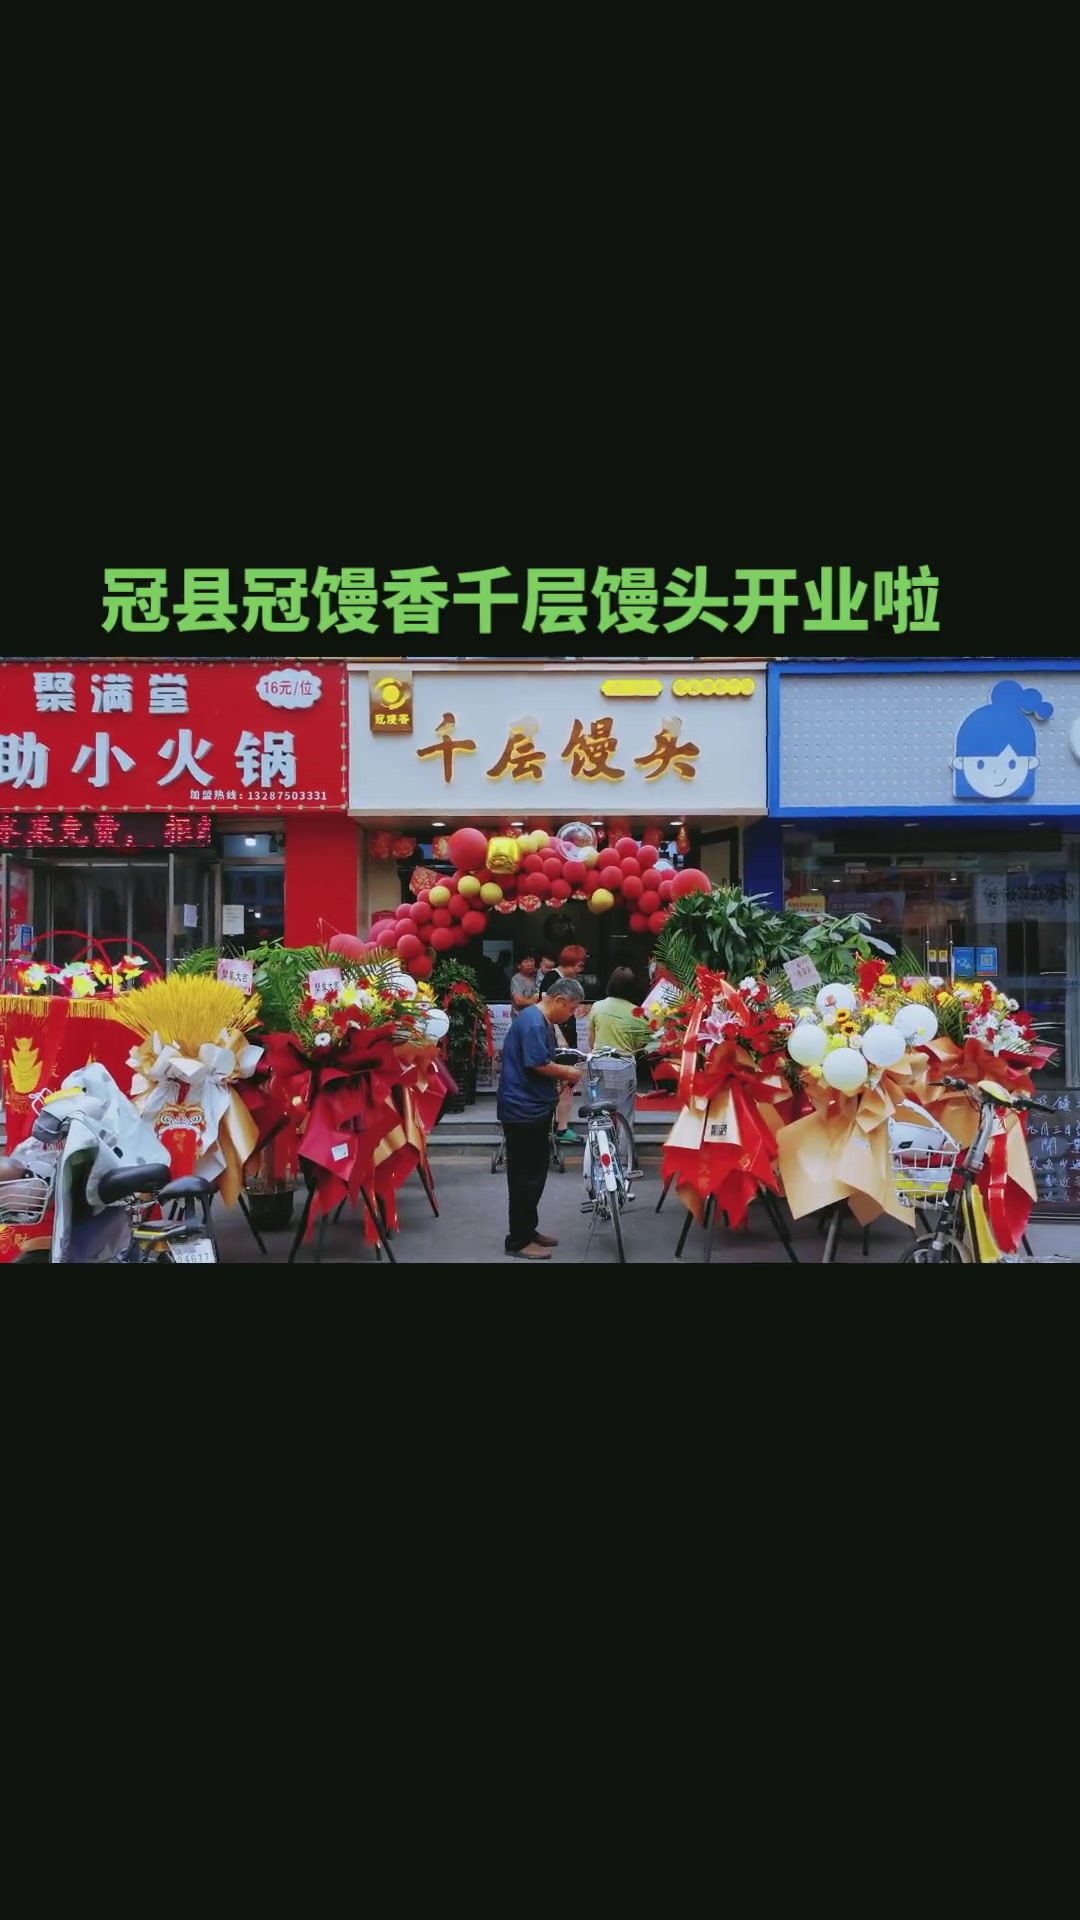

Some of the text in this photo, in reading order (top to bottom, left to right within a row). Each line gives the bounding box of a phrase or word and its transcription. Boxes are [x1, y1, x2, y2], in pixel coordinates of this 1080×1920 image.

[34, 671, 189, 713] 聚满堂
[263, 680, 314, 697] 16元/位
[0, 728, 298, 788] 助小火锅
[416, 712, 700, 782] 千层馒头
